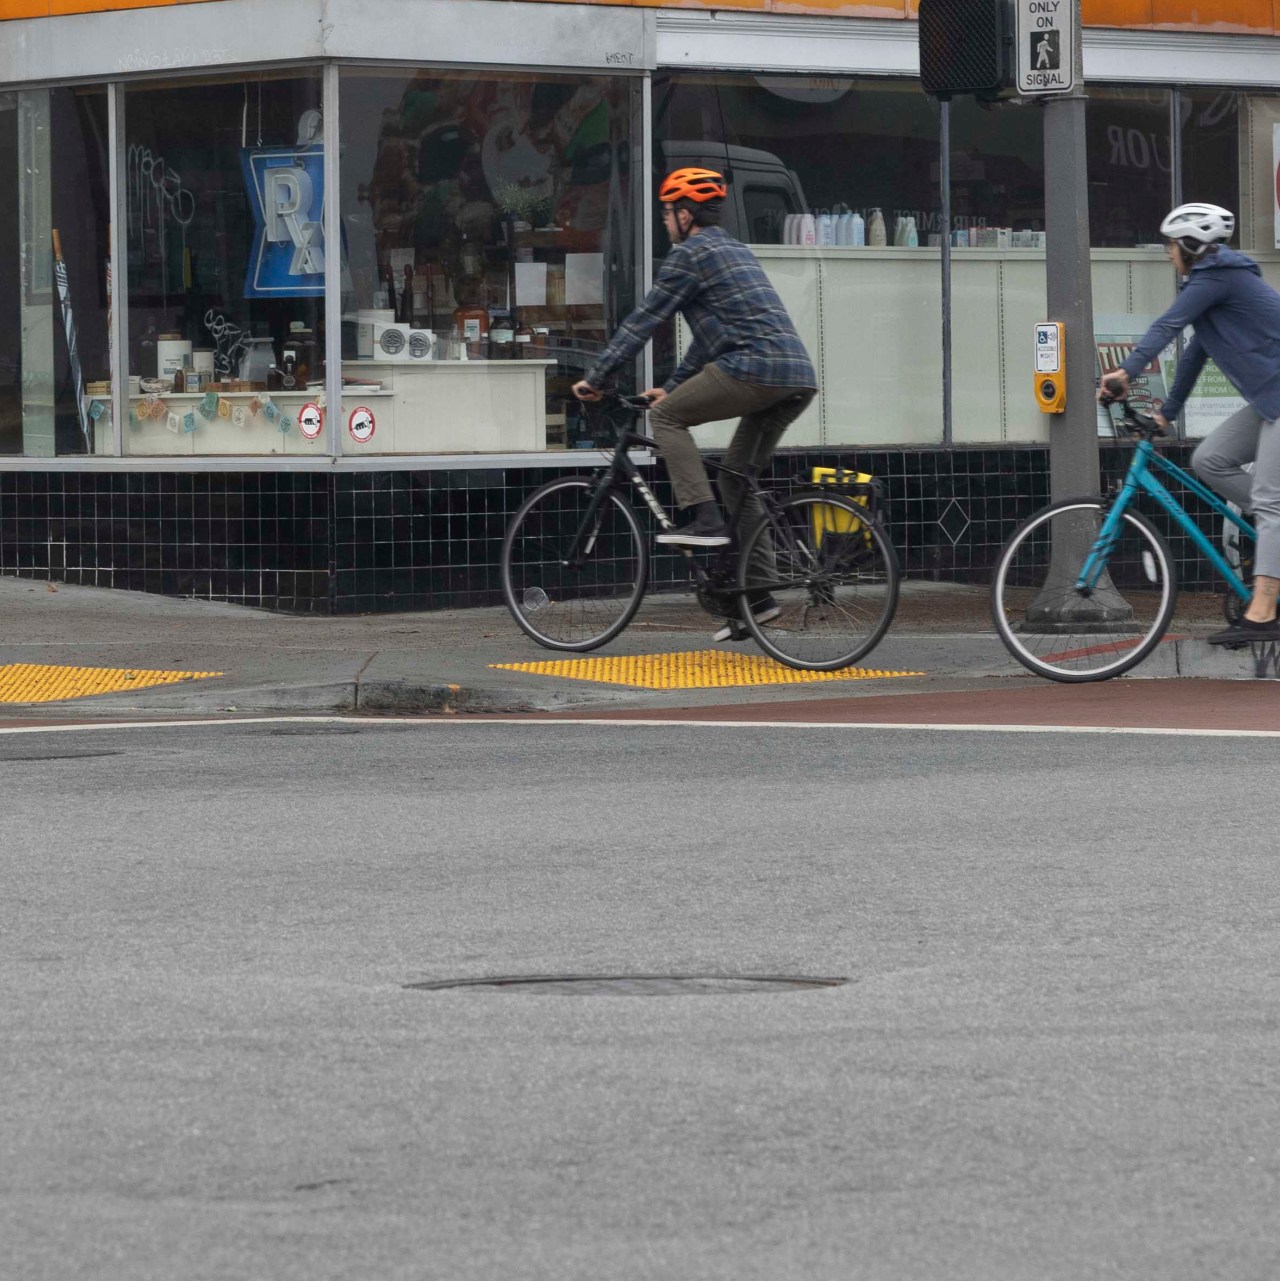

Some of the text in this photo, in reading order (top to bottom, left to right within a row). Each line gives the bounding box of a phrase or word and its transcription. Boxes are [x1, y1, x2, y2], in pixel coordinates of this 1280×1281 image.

[1028, 1, 1060, 14] ONLY
[1036, 16, 1053, 28] ON
[1026, 73, 1064, 86] SIGNAL
